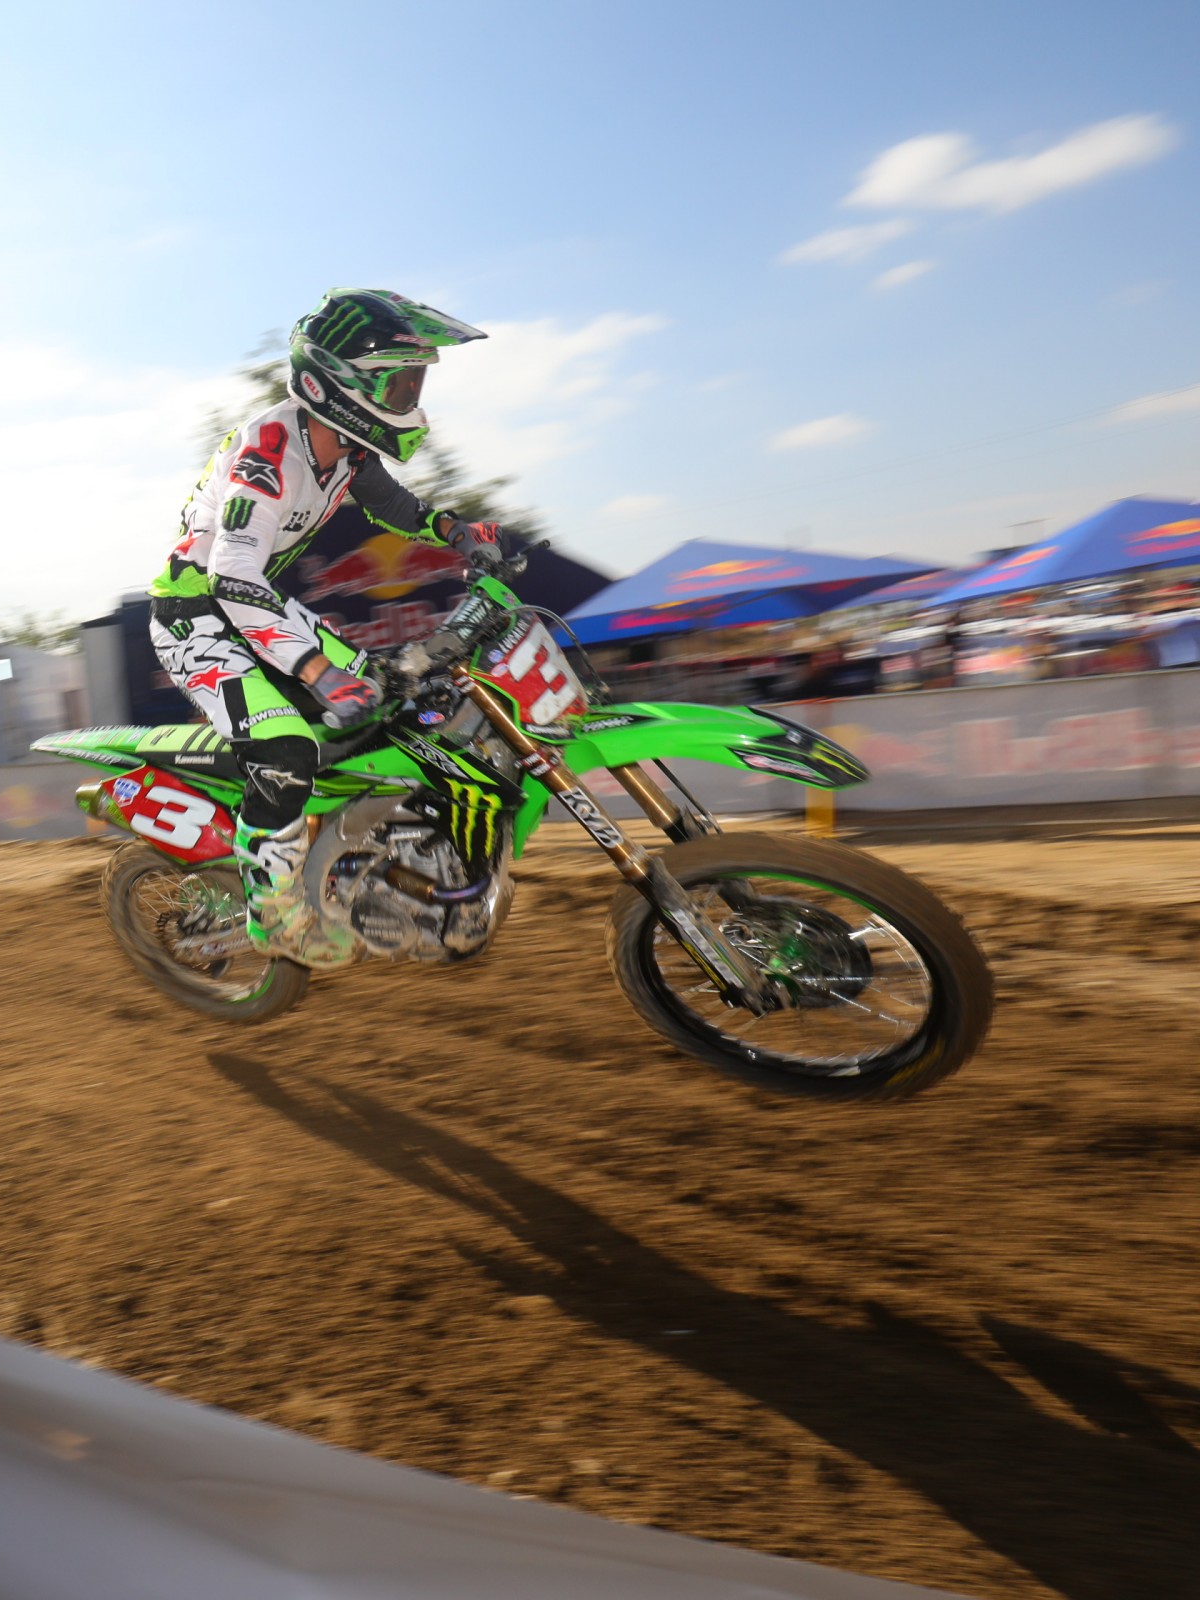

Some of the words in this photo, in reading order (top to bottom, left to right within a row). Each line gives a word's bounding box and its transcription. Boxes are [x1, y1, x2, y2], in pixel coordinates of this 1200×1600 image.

[303, 375, 321, 398] BELL
[301, 428, 318, 466] Kawasaki
[508, 621, 580, 726] 3
[238, 705, 302, 732] Kawasaki
[174, 753, 215, 765] Kawasaki
[130, 786, 216, 849] 3
